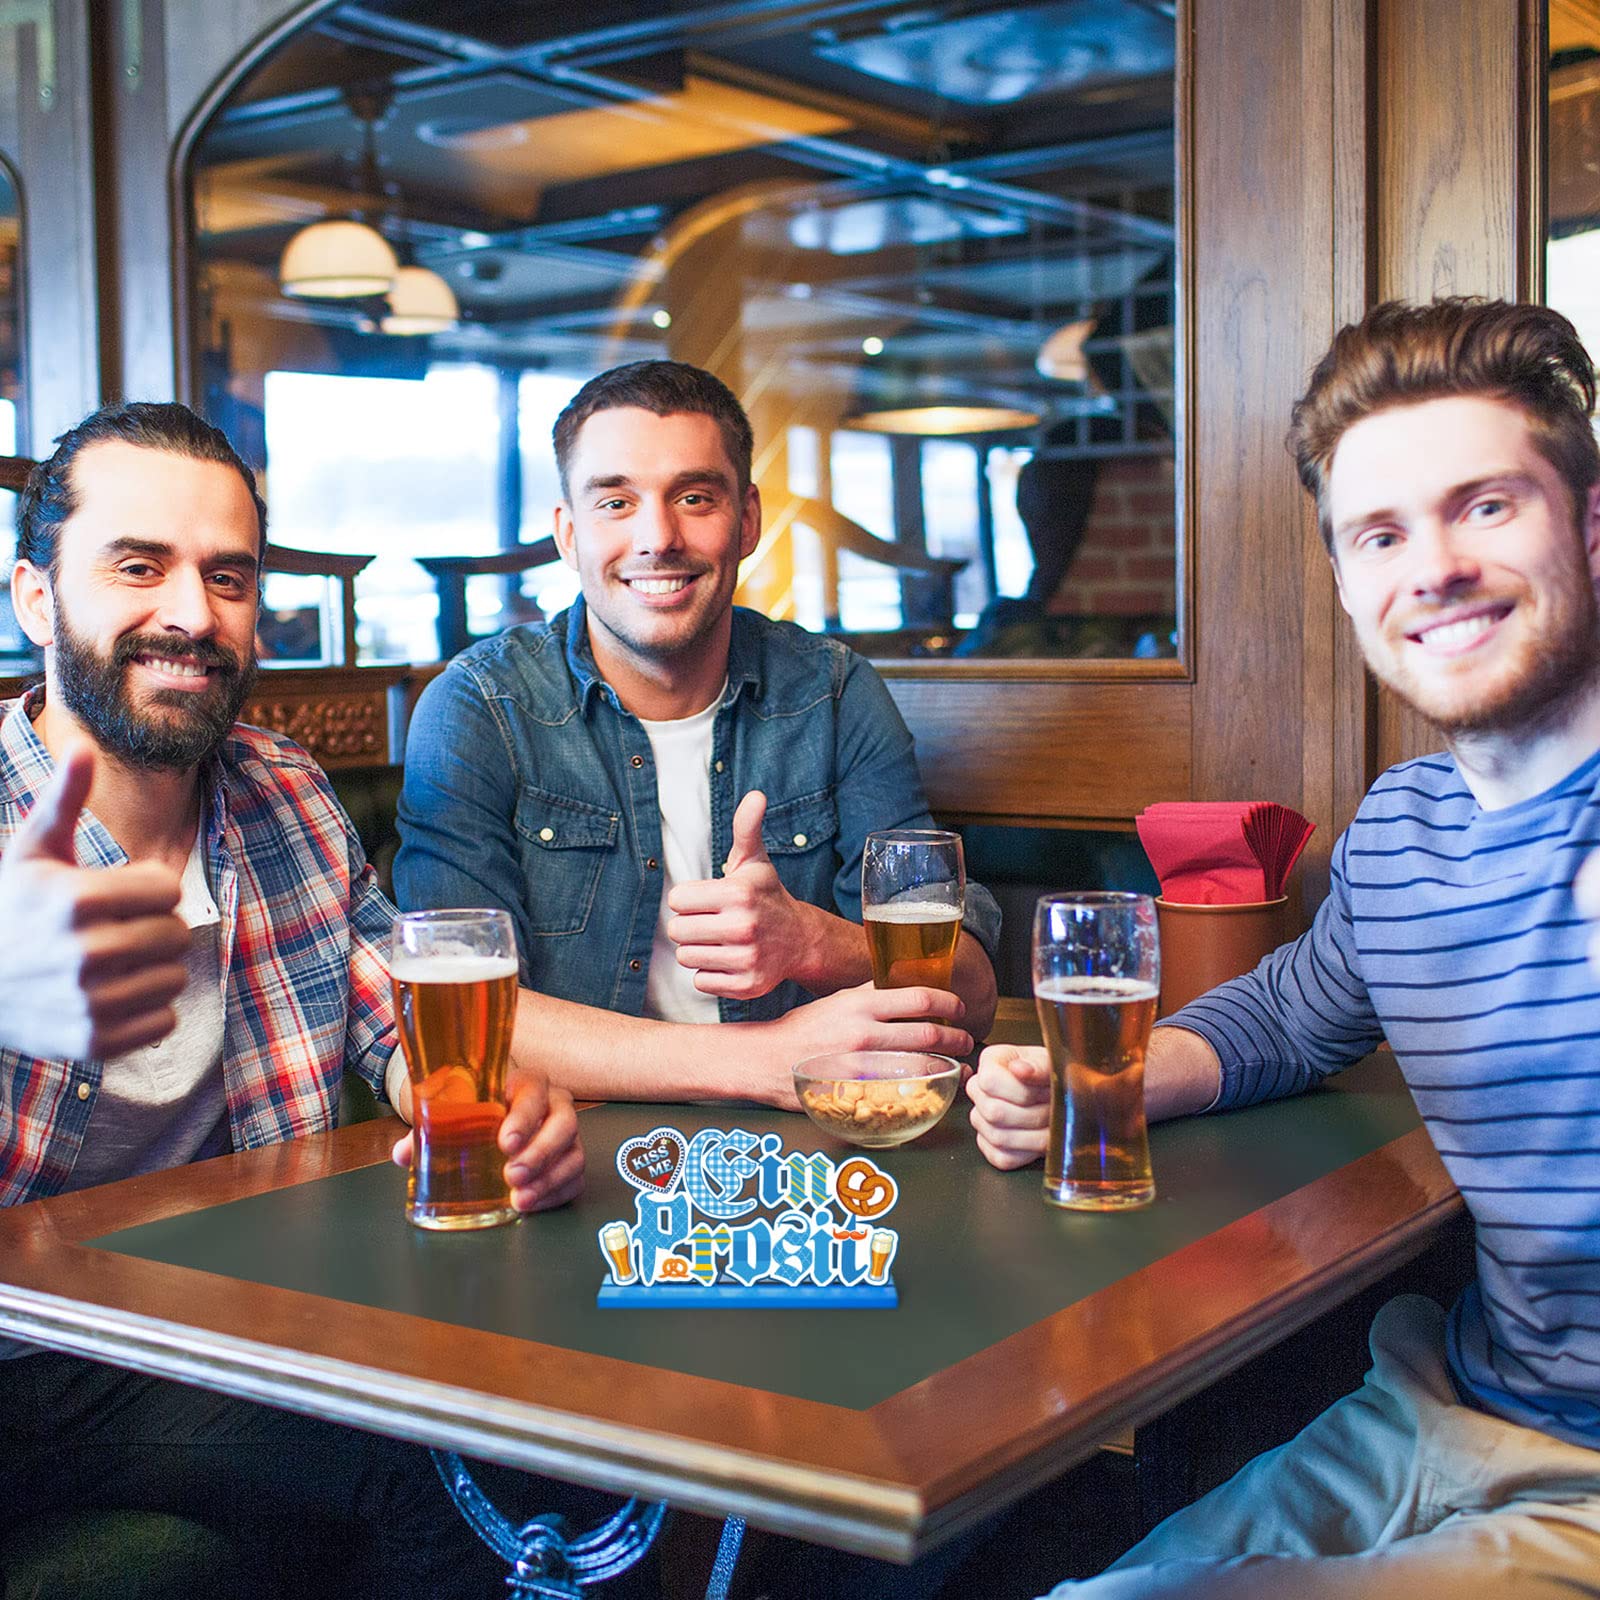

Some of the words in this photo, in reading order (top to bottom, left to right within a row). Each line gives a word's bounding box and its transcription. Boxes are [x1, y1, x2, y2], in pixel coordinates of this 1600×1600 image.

[631, 1144, 670, 1171] KISS
[648, 1157, 674, 1179] ME
[684, 1130, 836, 1216] Ein
[632, 1192, 868, 1284] Prosit
